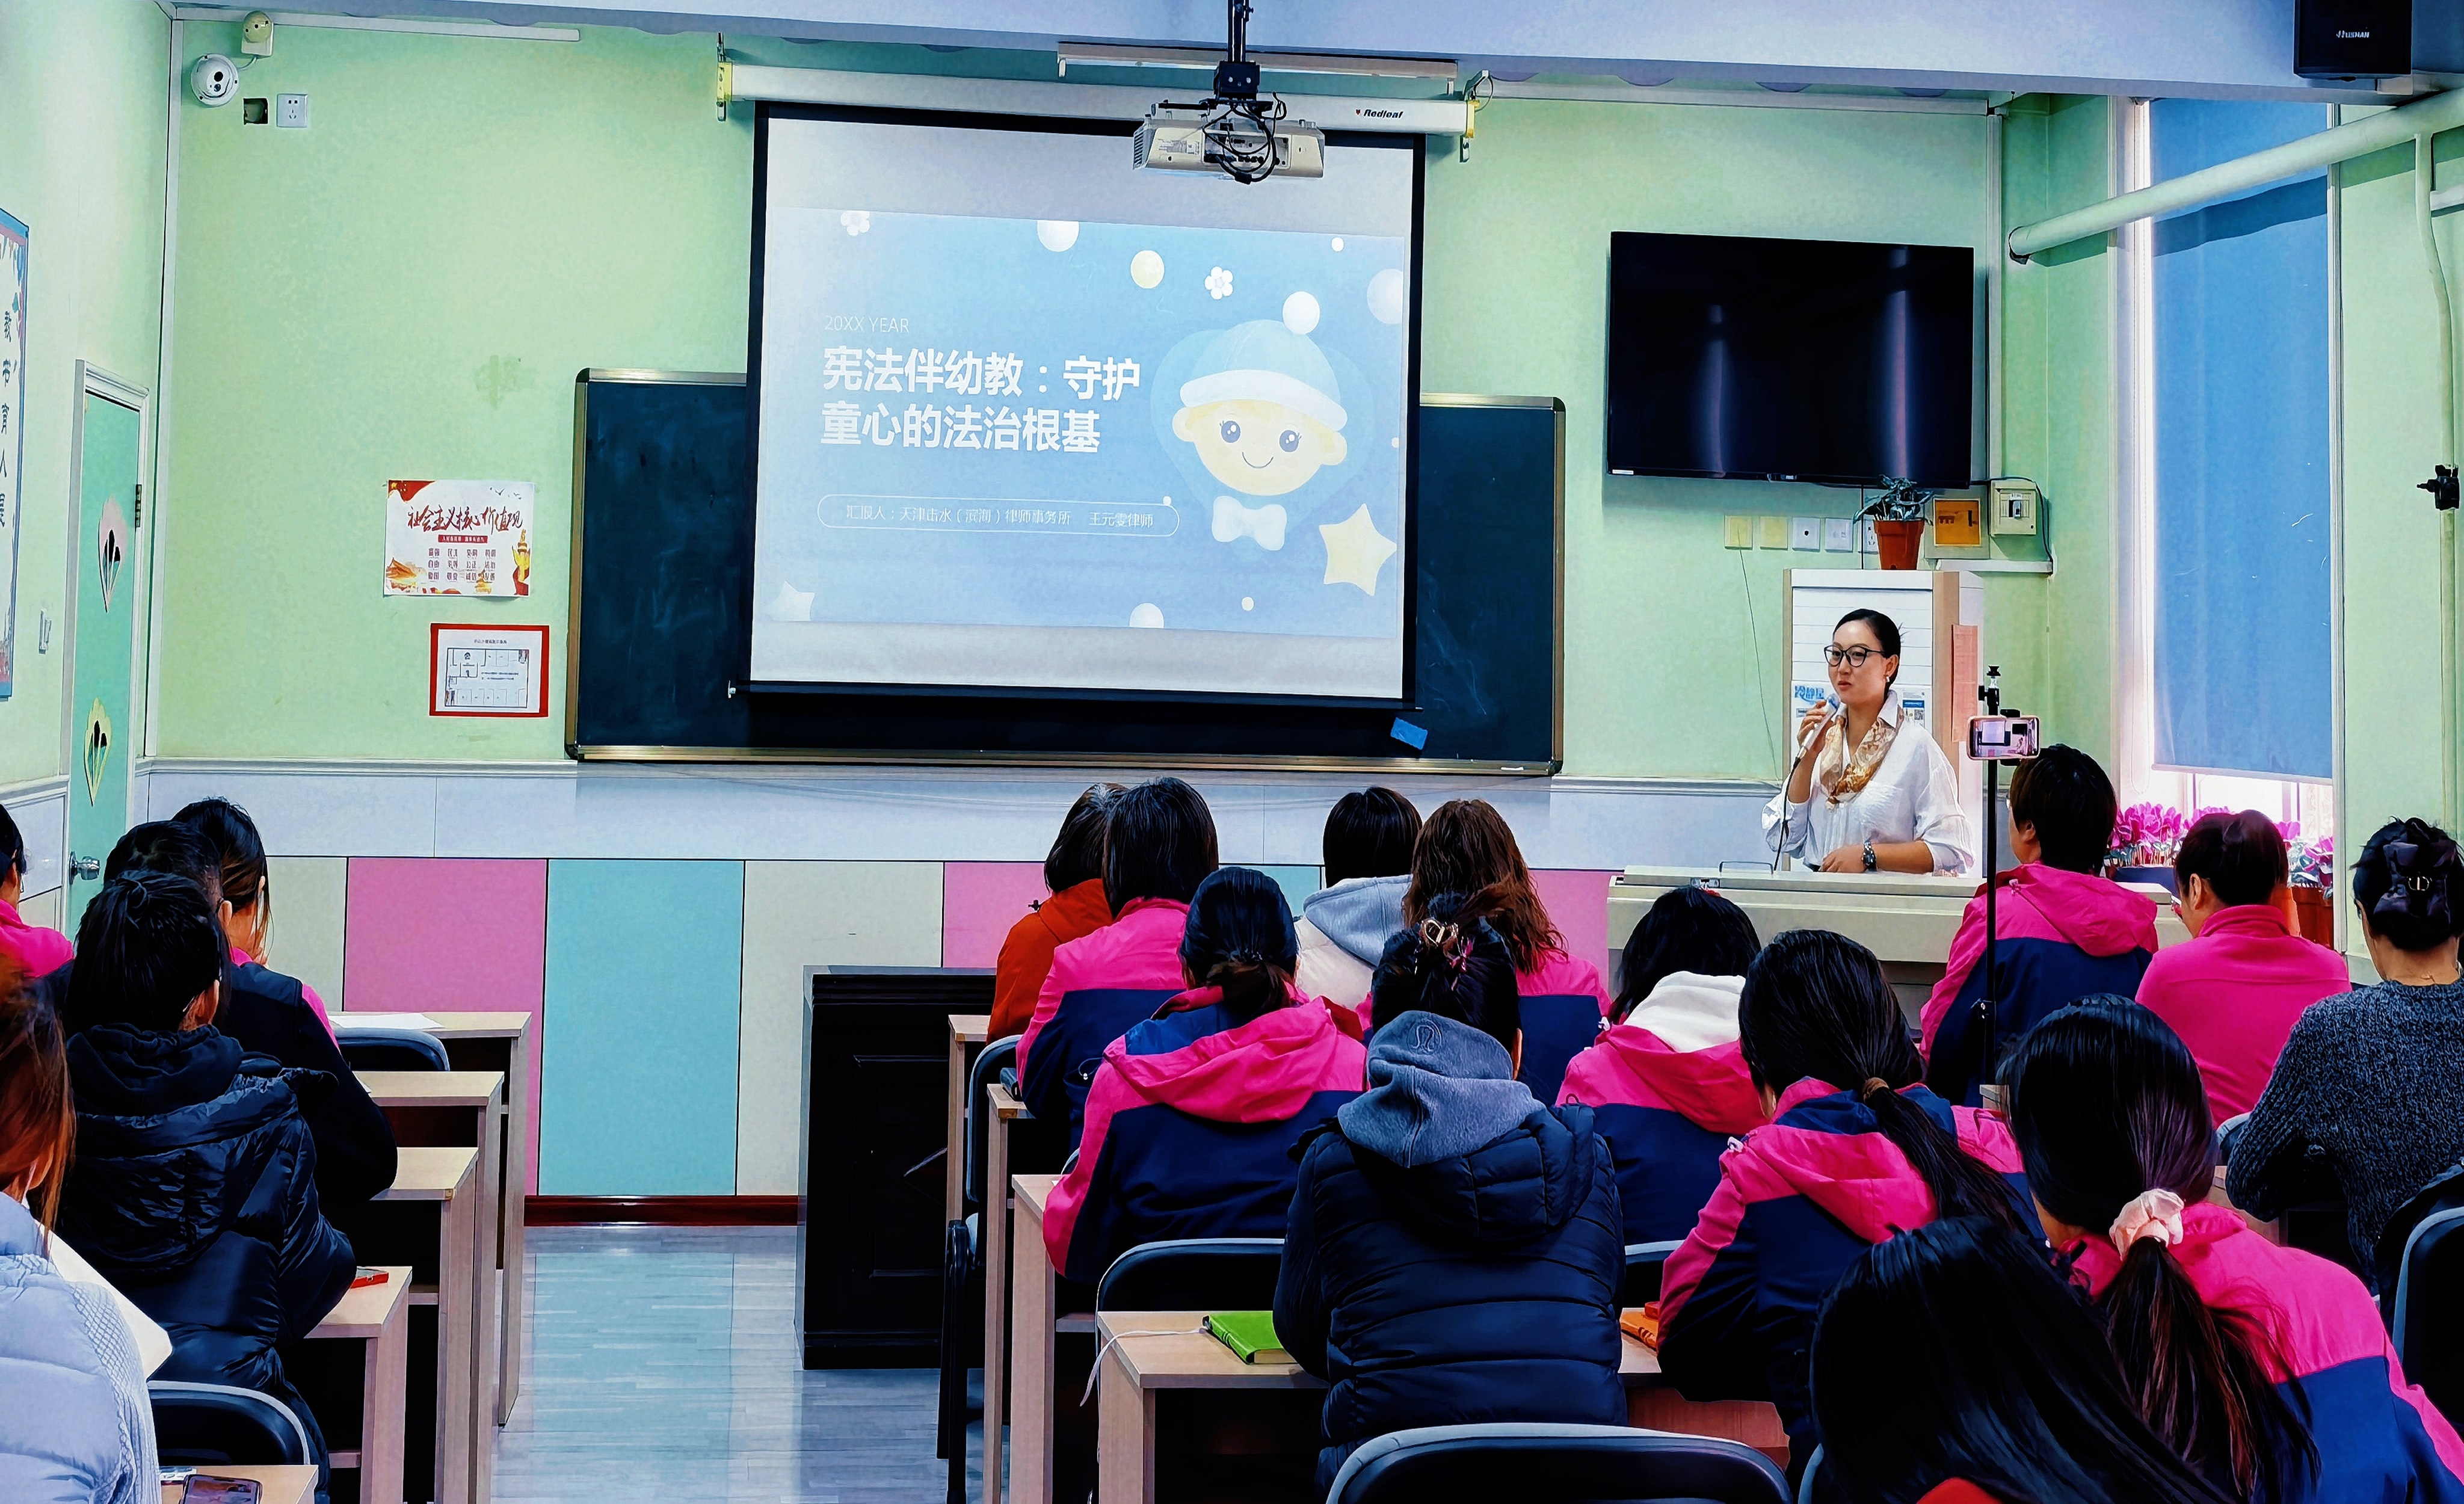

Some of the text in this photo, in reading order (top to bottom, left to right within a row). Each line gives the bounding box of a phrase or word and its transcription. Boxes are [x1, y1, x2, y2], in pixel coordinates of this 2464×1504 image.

[824, 315, 910, 333] 20XX YEAR
[823, 345, 1142, 402] 宪法伴幼教：守护
[821, 401, 1101, 454] 童心的法治根基
